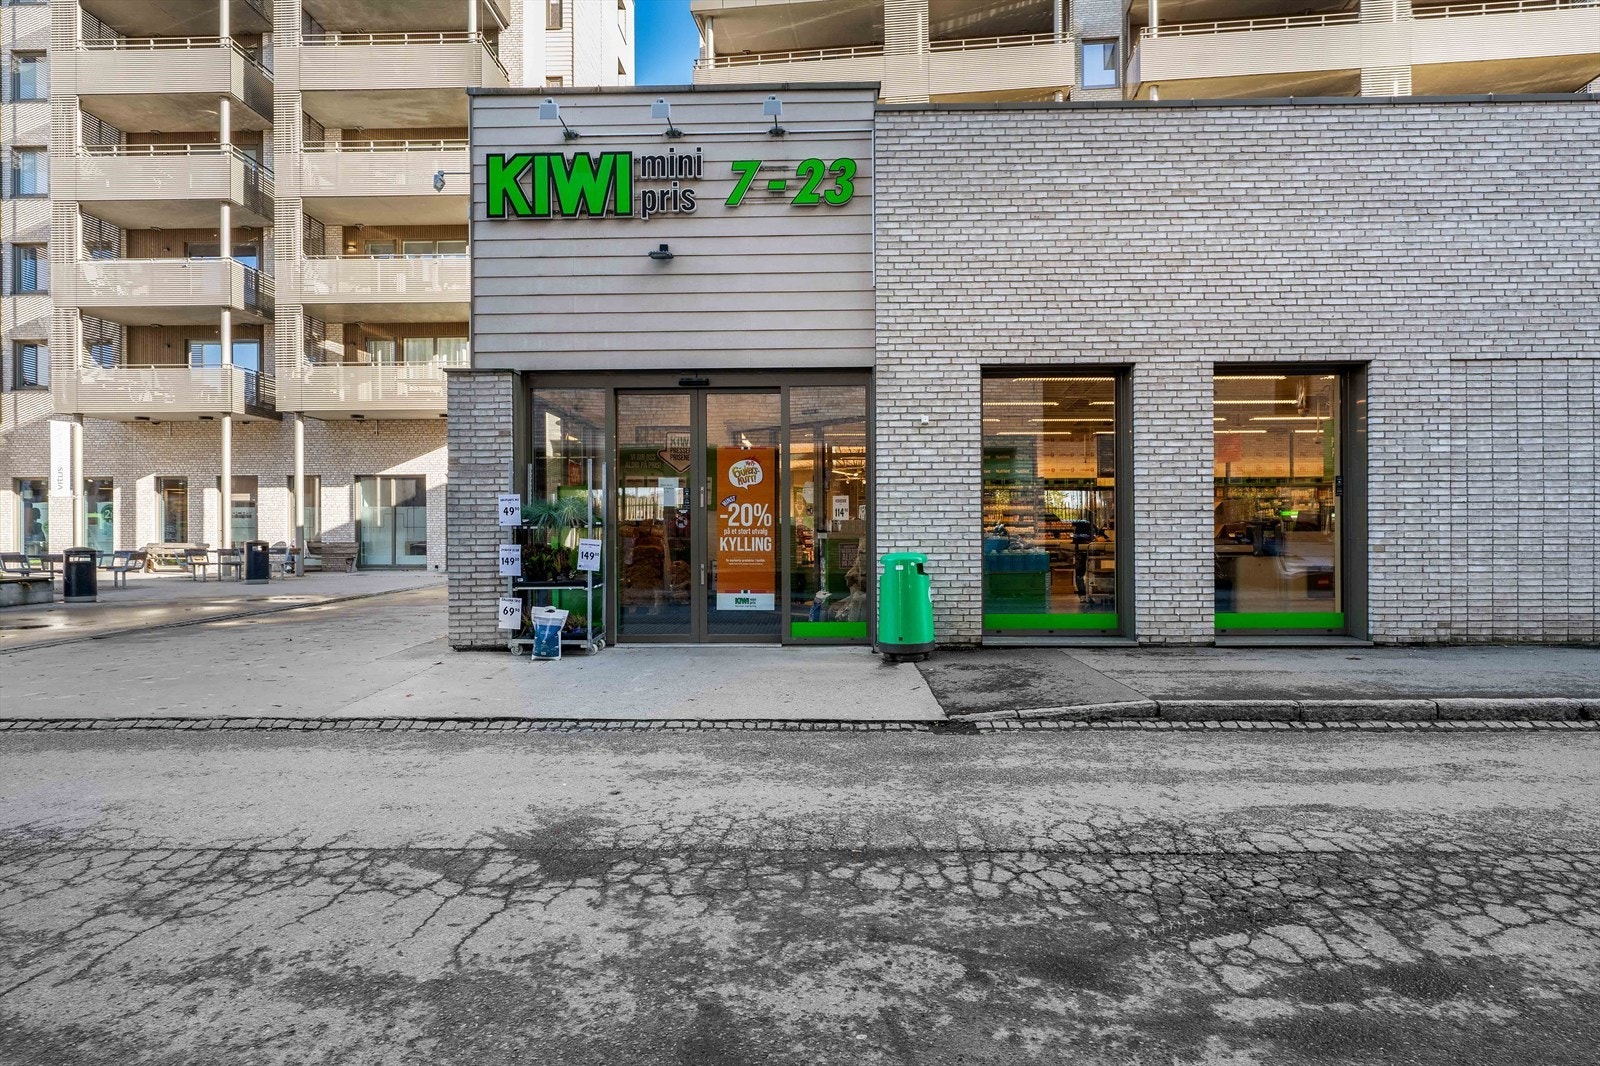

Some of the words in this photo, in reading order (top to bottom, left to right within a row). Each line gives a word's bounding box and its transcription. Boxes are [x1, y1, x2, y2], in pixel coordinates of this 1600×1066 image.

[640, 147, 704, 179] mini
[486, 151, 634, 219] KIWI
[640, 181, 698, 220] pris
[720, 503, 772, 527] -20%
[723, 527, 730, 536] på
[752, 528, 768, 536] utvalg
[720, 536, 772, 552] KYLLING
